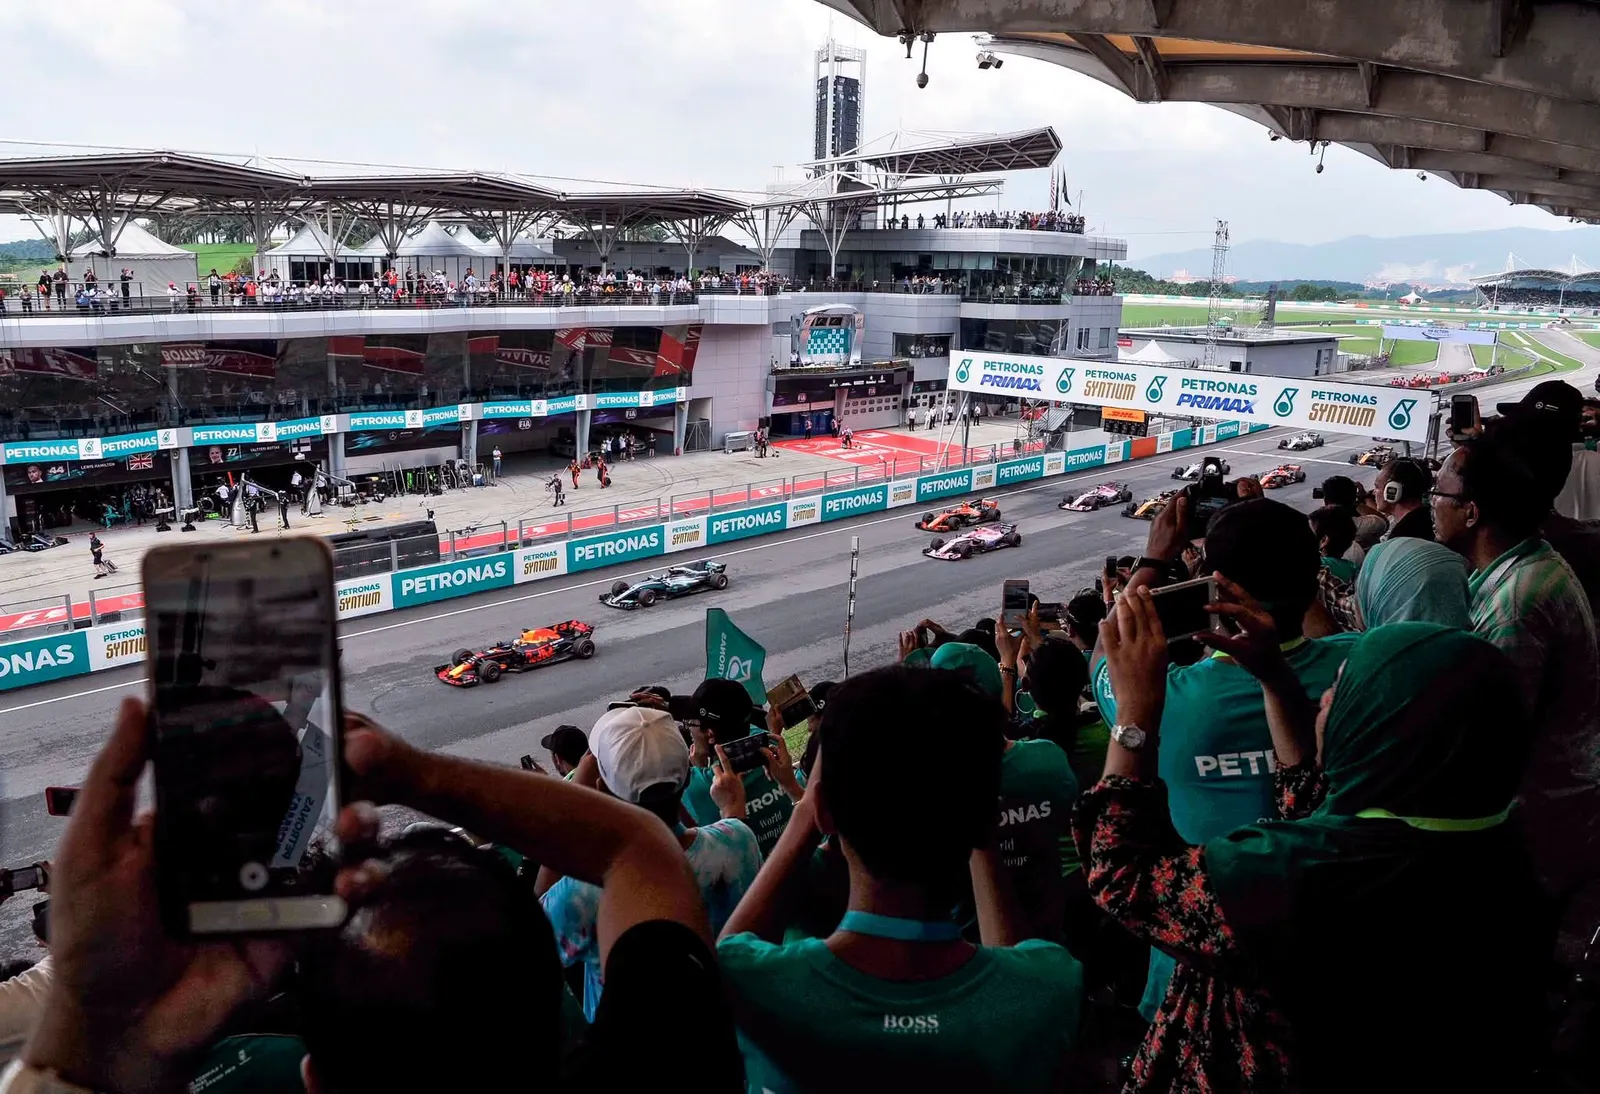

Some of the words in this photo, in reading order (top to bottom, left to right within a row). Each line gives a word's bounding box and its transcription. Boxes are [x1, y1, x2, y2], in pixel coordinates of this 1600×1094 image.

[982, 360, 1044, 376] PETRONAS
[1085, 369, 1137, 382] PETRONAS
[980, 374, 1043, 392] PRIMAX
[1083, 380, 1137, 401] SYNTIUM
[1181, 378, 1258, 396] PETRONAS
[547, 399, 576, 411] PETRONAS
[597, 395, 639, 406] PETRONAS
[1176, 393, 1259, 415] PRIMAX
[1310, 390, 1378, 406] PETRONAS
[423, 408, 458, 423] PETRONAS
[483, 404, 531, 415] PETRONAS
[1111, 410, 1134, 418] DHL
[1308, 402, 1377, 428] SYNTIUM
[350, 415, 405, 427] PETRONAS
[518, 420, 532, 430] FIA
[193, 428, 256, 442] PETRONAS
[276, 422, 321, 437] PETRONAS
[1217, 423, 1239, 436] PETRONAS
[6, 443, 78, 460] PETRONAS
[102, 436, 157, 454] PETRONAS
[227, 447, 238, 457] 77
[1067, 450, 1103, 466] PETRONAS
[49, 465, 65, 475] 44
[1000, 461, 1041, 479] PETRONAS
[920, 474, 969, 495] PETRONAS
[793, 502, 816, 511] PETRONAS
[826, 490, 883, 514] PETRONAS
[672, 523, 700, 534] PETRONAS
[712, 509, 782, 536] PETRONAS
[671, 530, 700, 546] SYNTIUM
[575, 531, 659, 563] PETRONAS
[523, 550, 557, 562] PETRONAS
[524, 557, 558, 575] SYNTIUM
[401, 561, 506, 597] PETRONAS
[338, 582, 380, 597] PETRONAS
[339, 591, 381, 612] SYNTIUM
[103, 627, 147, 643] PETRON
[105, 636, 148, 660] SYNTIU
[745, 785, 786, 815] TRON
[759, 809, 783, 829] World
[756, 820, 788, 844] hampio
[883, 1014, 939, 1029] BOSS
